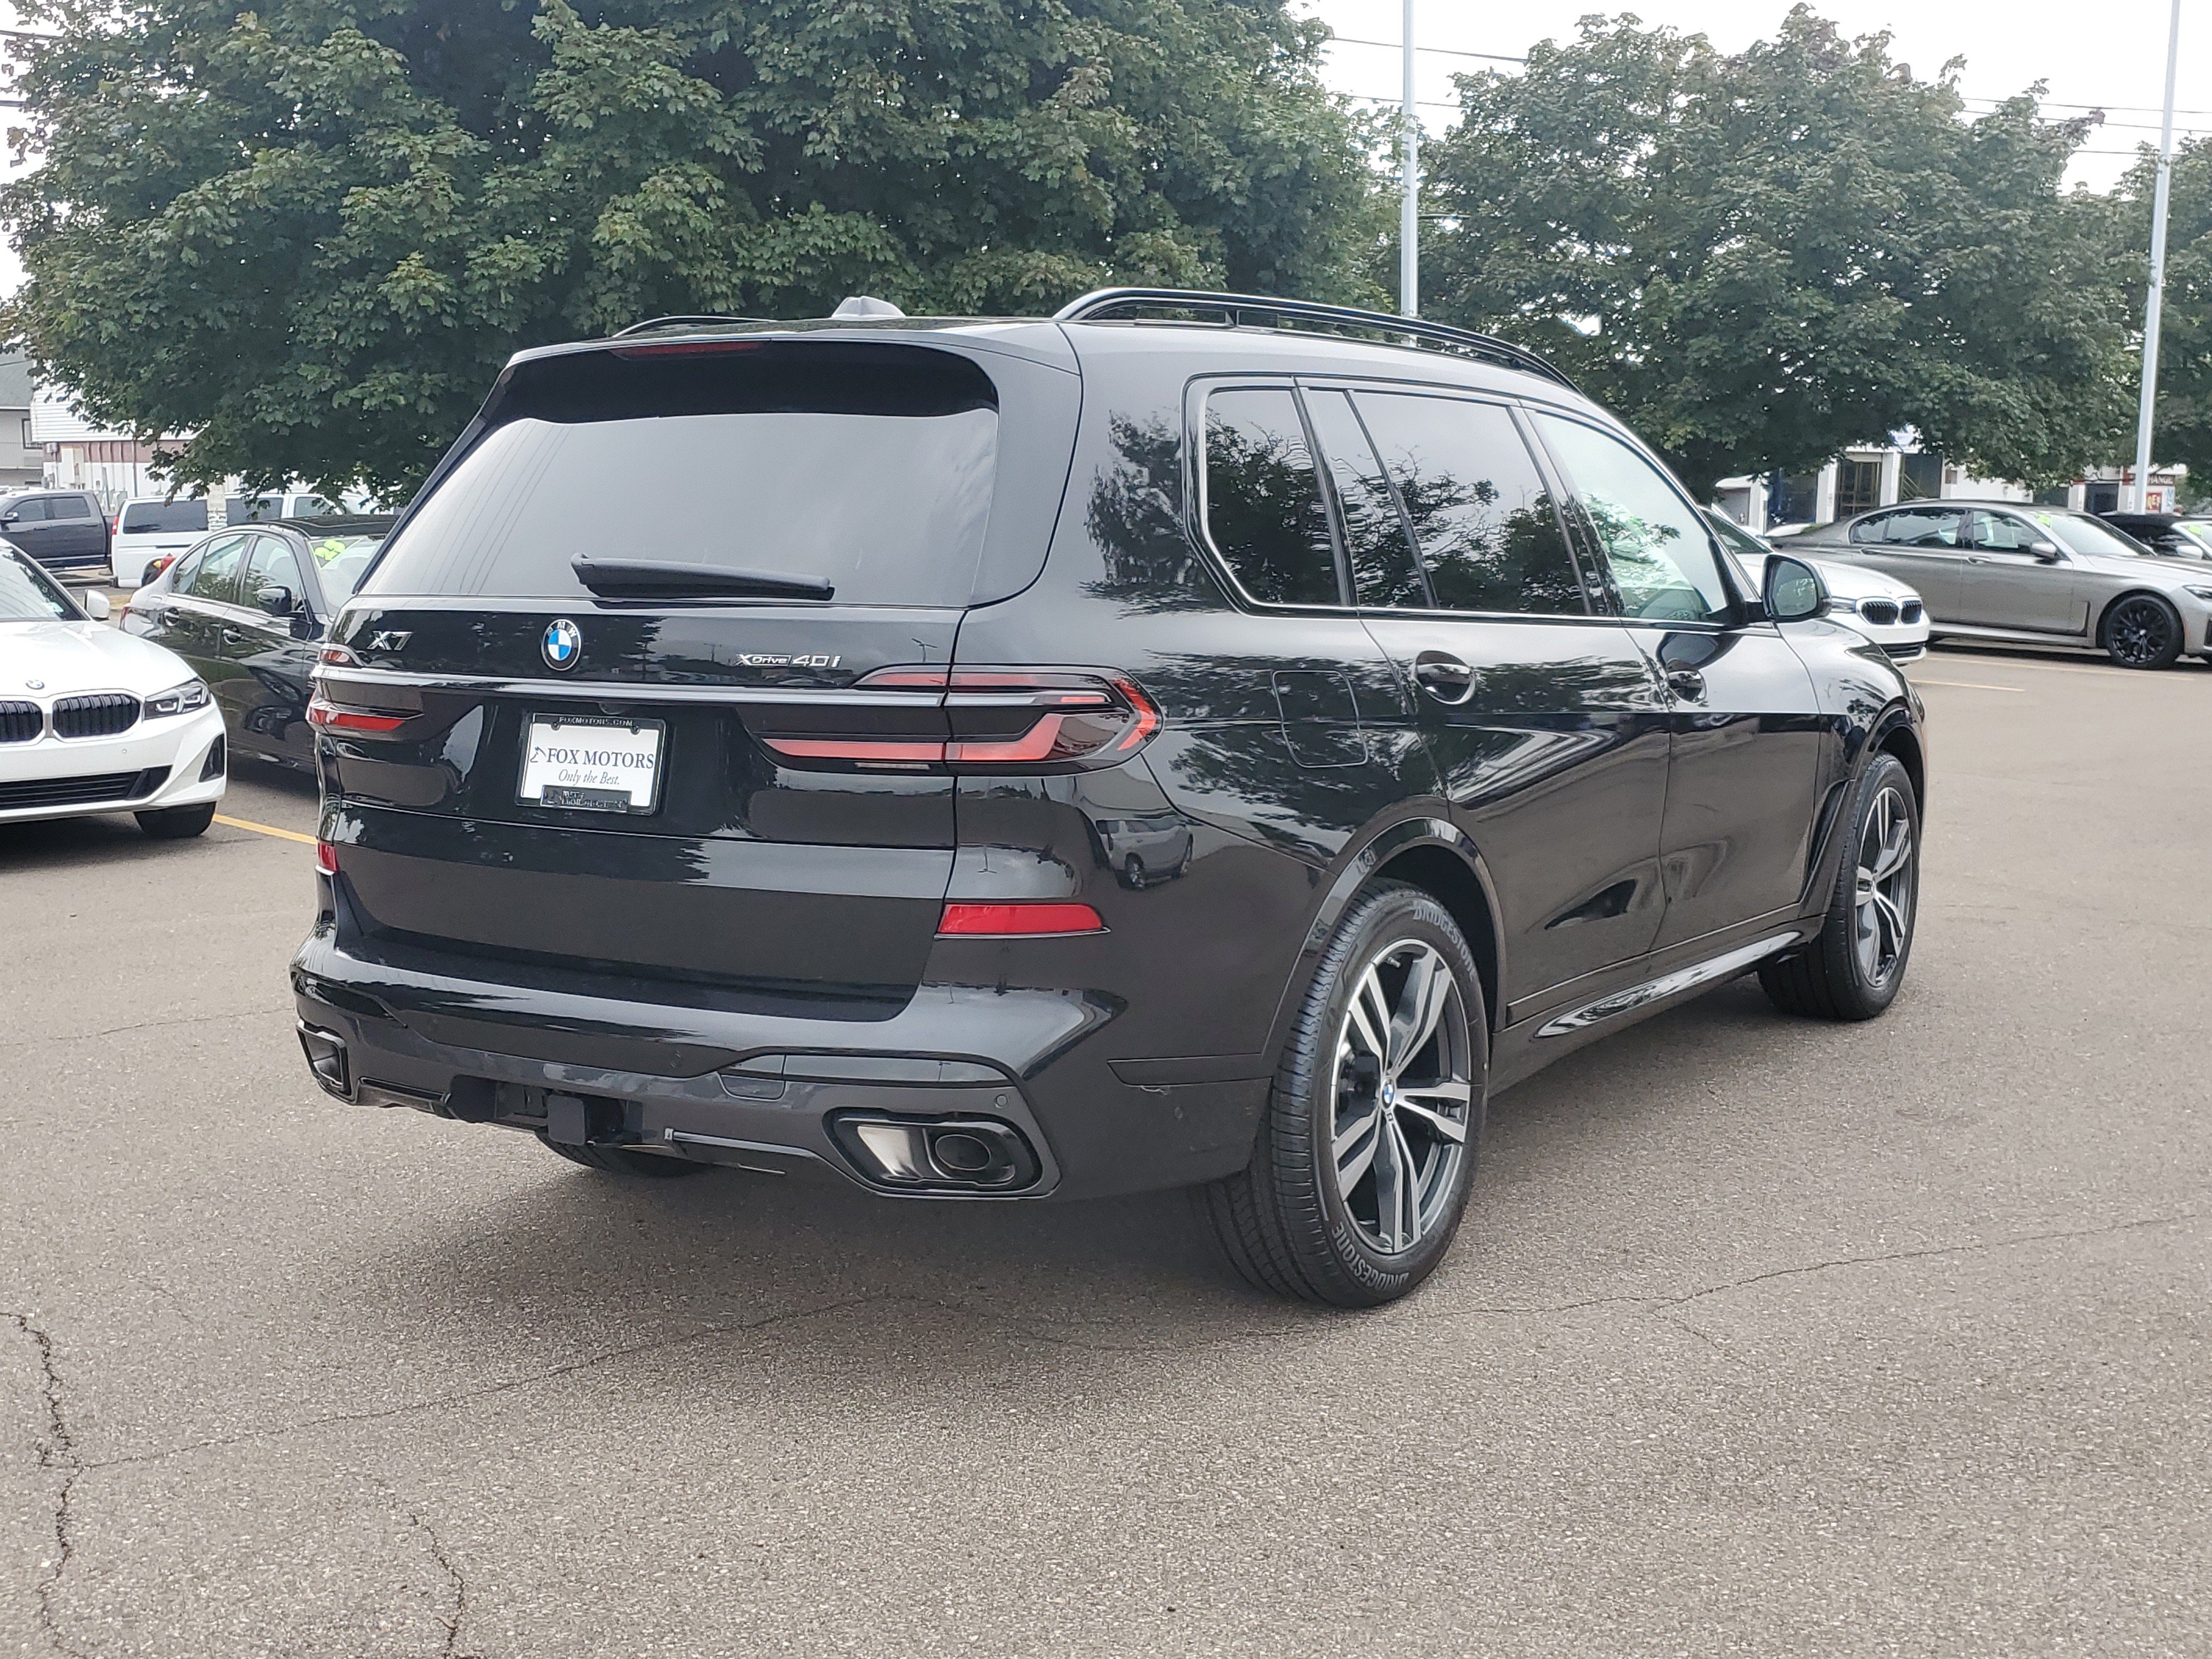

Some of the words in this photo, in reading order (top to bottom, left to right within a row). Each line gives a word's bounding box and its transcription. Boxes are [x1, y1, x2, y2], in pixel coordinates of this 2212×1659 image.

[2148, 475, 2174, 484] HANGE
[546, 621, 577, 637] BMW
[367, 630, 413, 651] X7
[546, 748, 580, 764] FOX
[583, 751, 654, 769] MOTORS
[558, 769, 580, 786] Only
[583, 770, 597, 784] the
[600, 771, 620, 785] Best.
